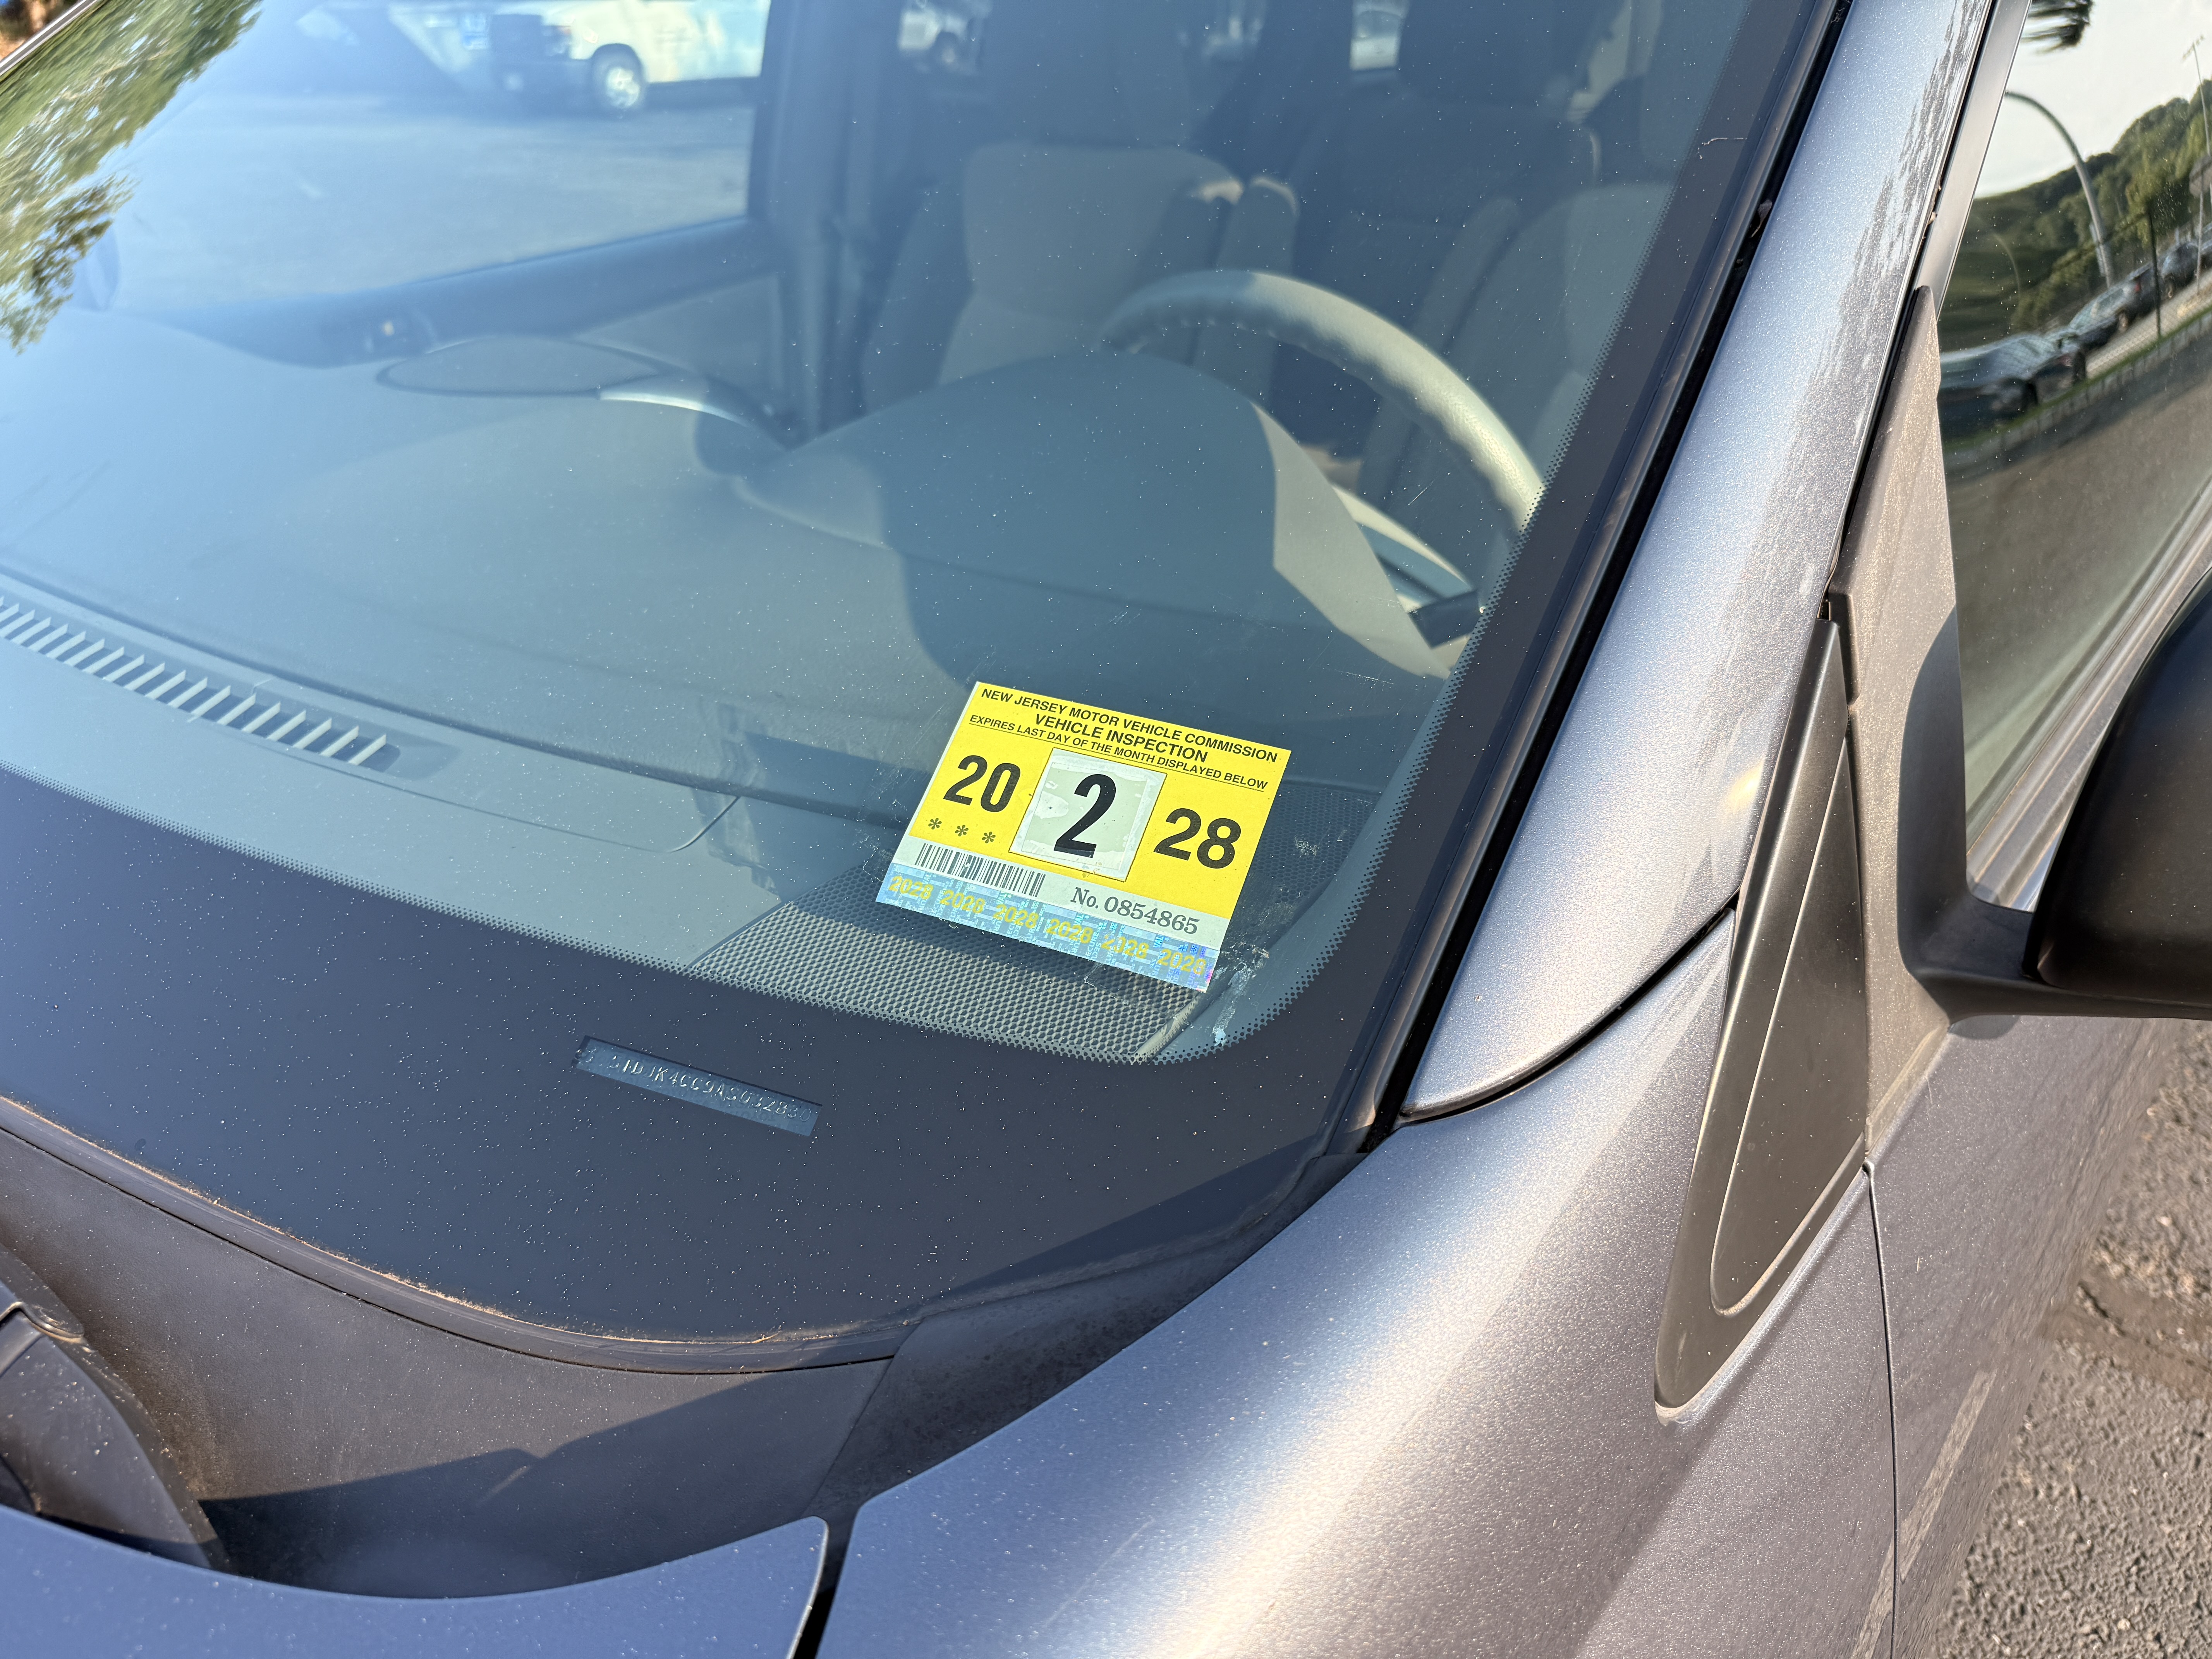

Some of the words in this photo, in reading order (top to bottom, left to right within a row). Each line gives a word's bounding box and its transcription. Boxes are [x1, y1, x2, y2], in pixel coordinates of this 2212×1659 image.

[970, 714, 1015, 730] EXPIRES
[1017, 725, 1046, 737] LAST
[1047, 732, 1071, 743] DAY
[1072, 738, 1089, 747] OF
[1091, 742, 1113, 753] THE
[1114, 747, 1155, 763] MONTH
[1157, 757, 1221, 778] DISPLAYED
[1224, 773, 1268, 789] BELOW
[981, 689, 1013, 702] NEW
[1014, 696, 1067, 714] JERSEY
[1069, 708, 1119, 726] MOTOR
[1124, 719, 1182, 740] VEHICLE
[1185, 733, 1278, 762] COMMISSION
[1036, 713, 1104, 738] VEHICLE
[1106, 730, 1208, 763] INSPECTION
[943, 755, 1021, 812] 20
[1054, 774, 1116, 858] 2
[1154, 808, 1242, 869] 28
[888, 876, 933, 900] 2028
[939, 889, 986, 914] 2028
[993, 903, 1039, 929] 2028
[1046, 919, 1094, 944] 2028
[1158, 949, 1207, 975] 2028
[1070, 887, 1099, 909] No.
[1104, 896, 1200, 934] 0854865
